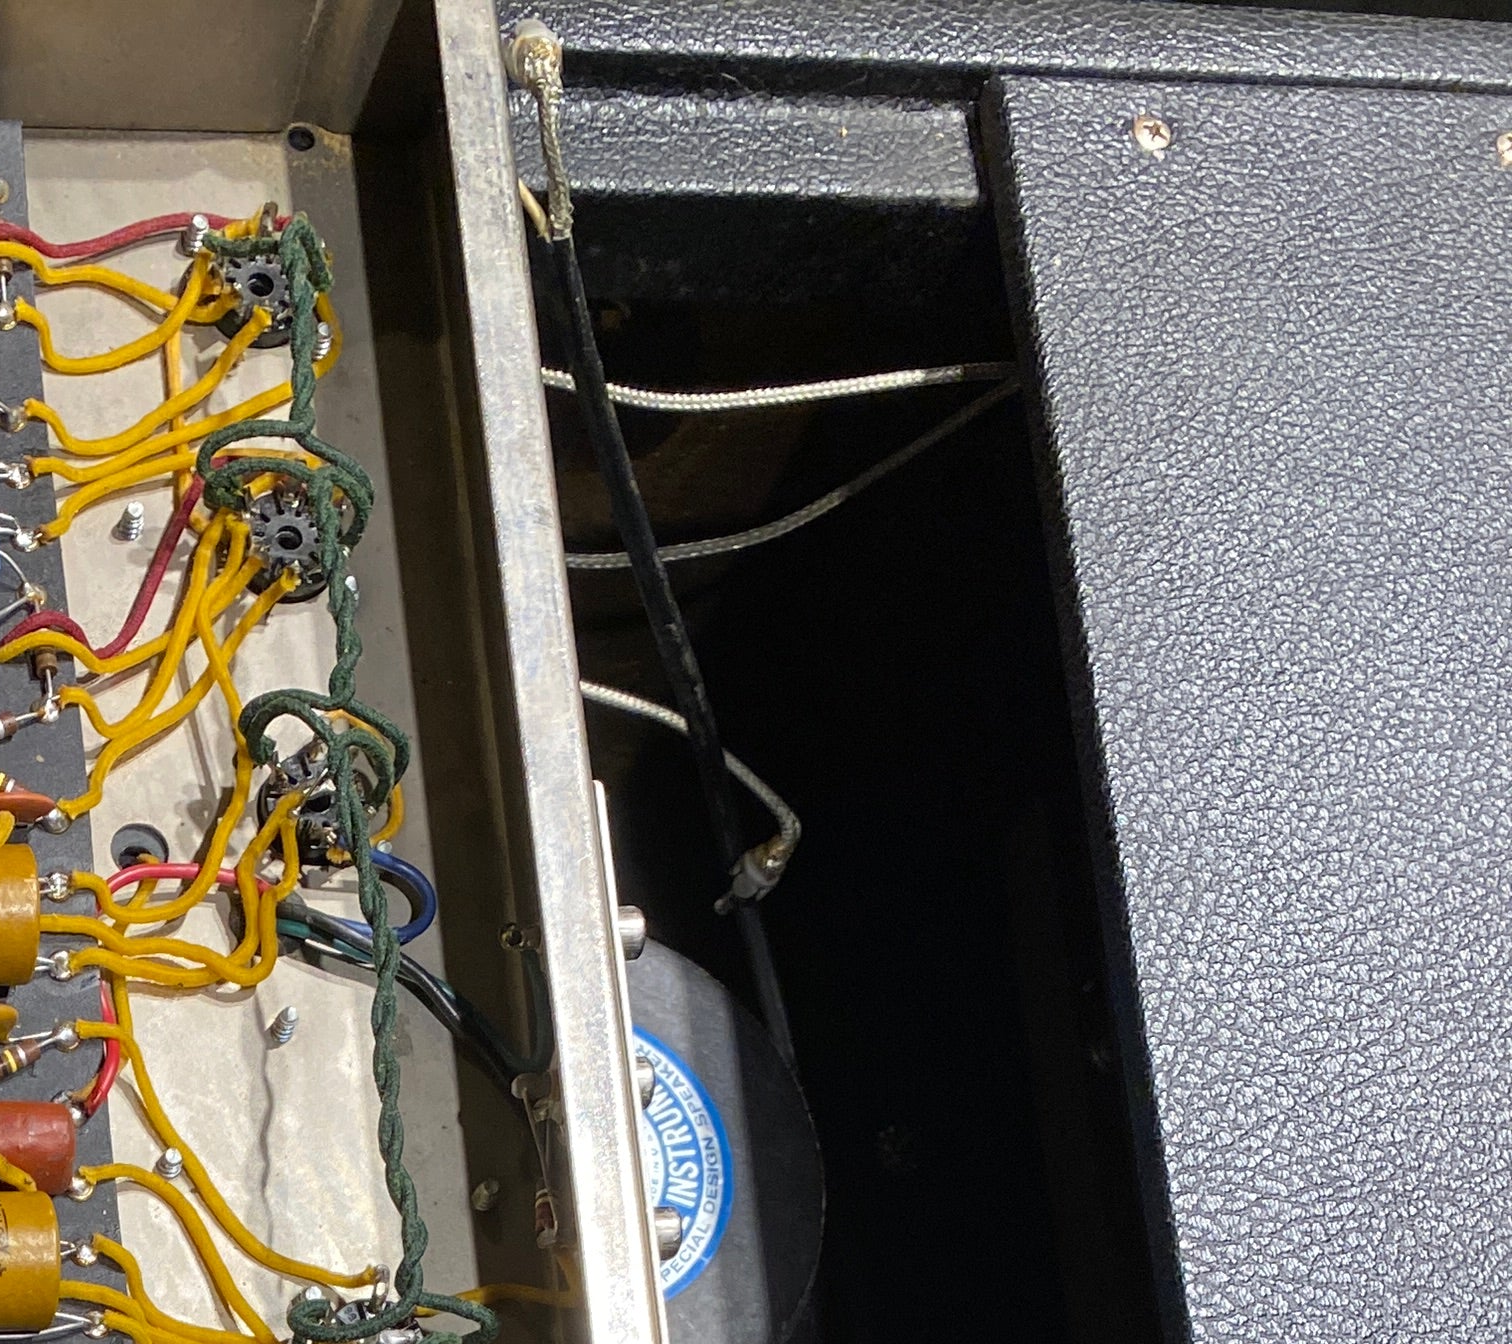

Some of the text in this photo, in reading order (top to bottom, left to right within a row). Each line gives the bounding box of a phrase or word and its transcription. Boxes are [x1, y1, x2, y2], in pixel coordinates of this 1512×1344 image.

[647, 1083, 699, 1207] INSTRUM
[660, 1223, 709, 1283] PECIAL
[702, 1135, 719, 1215] DESIGN
